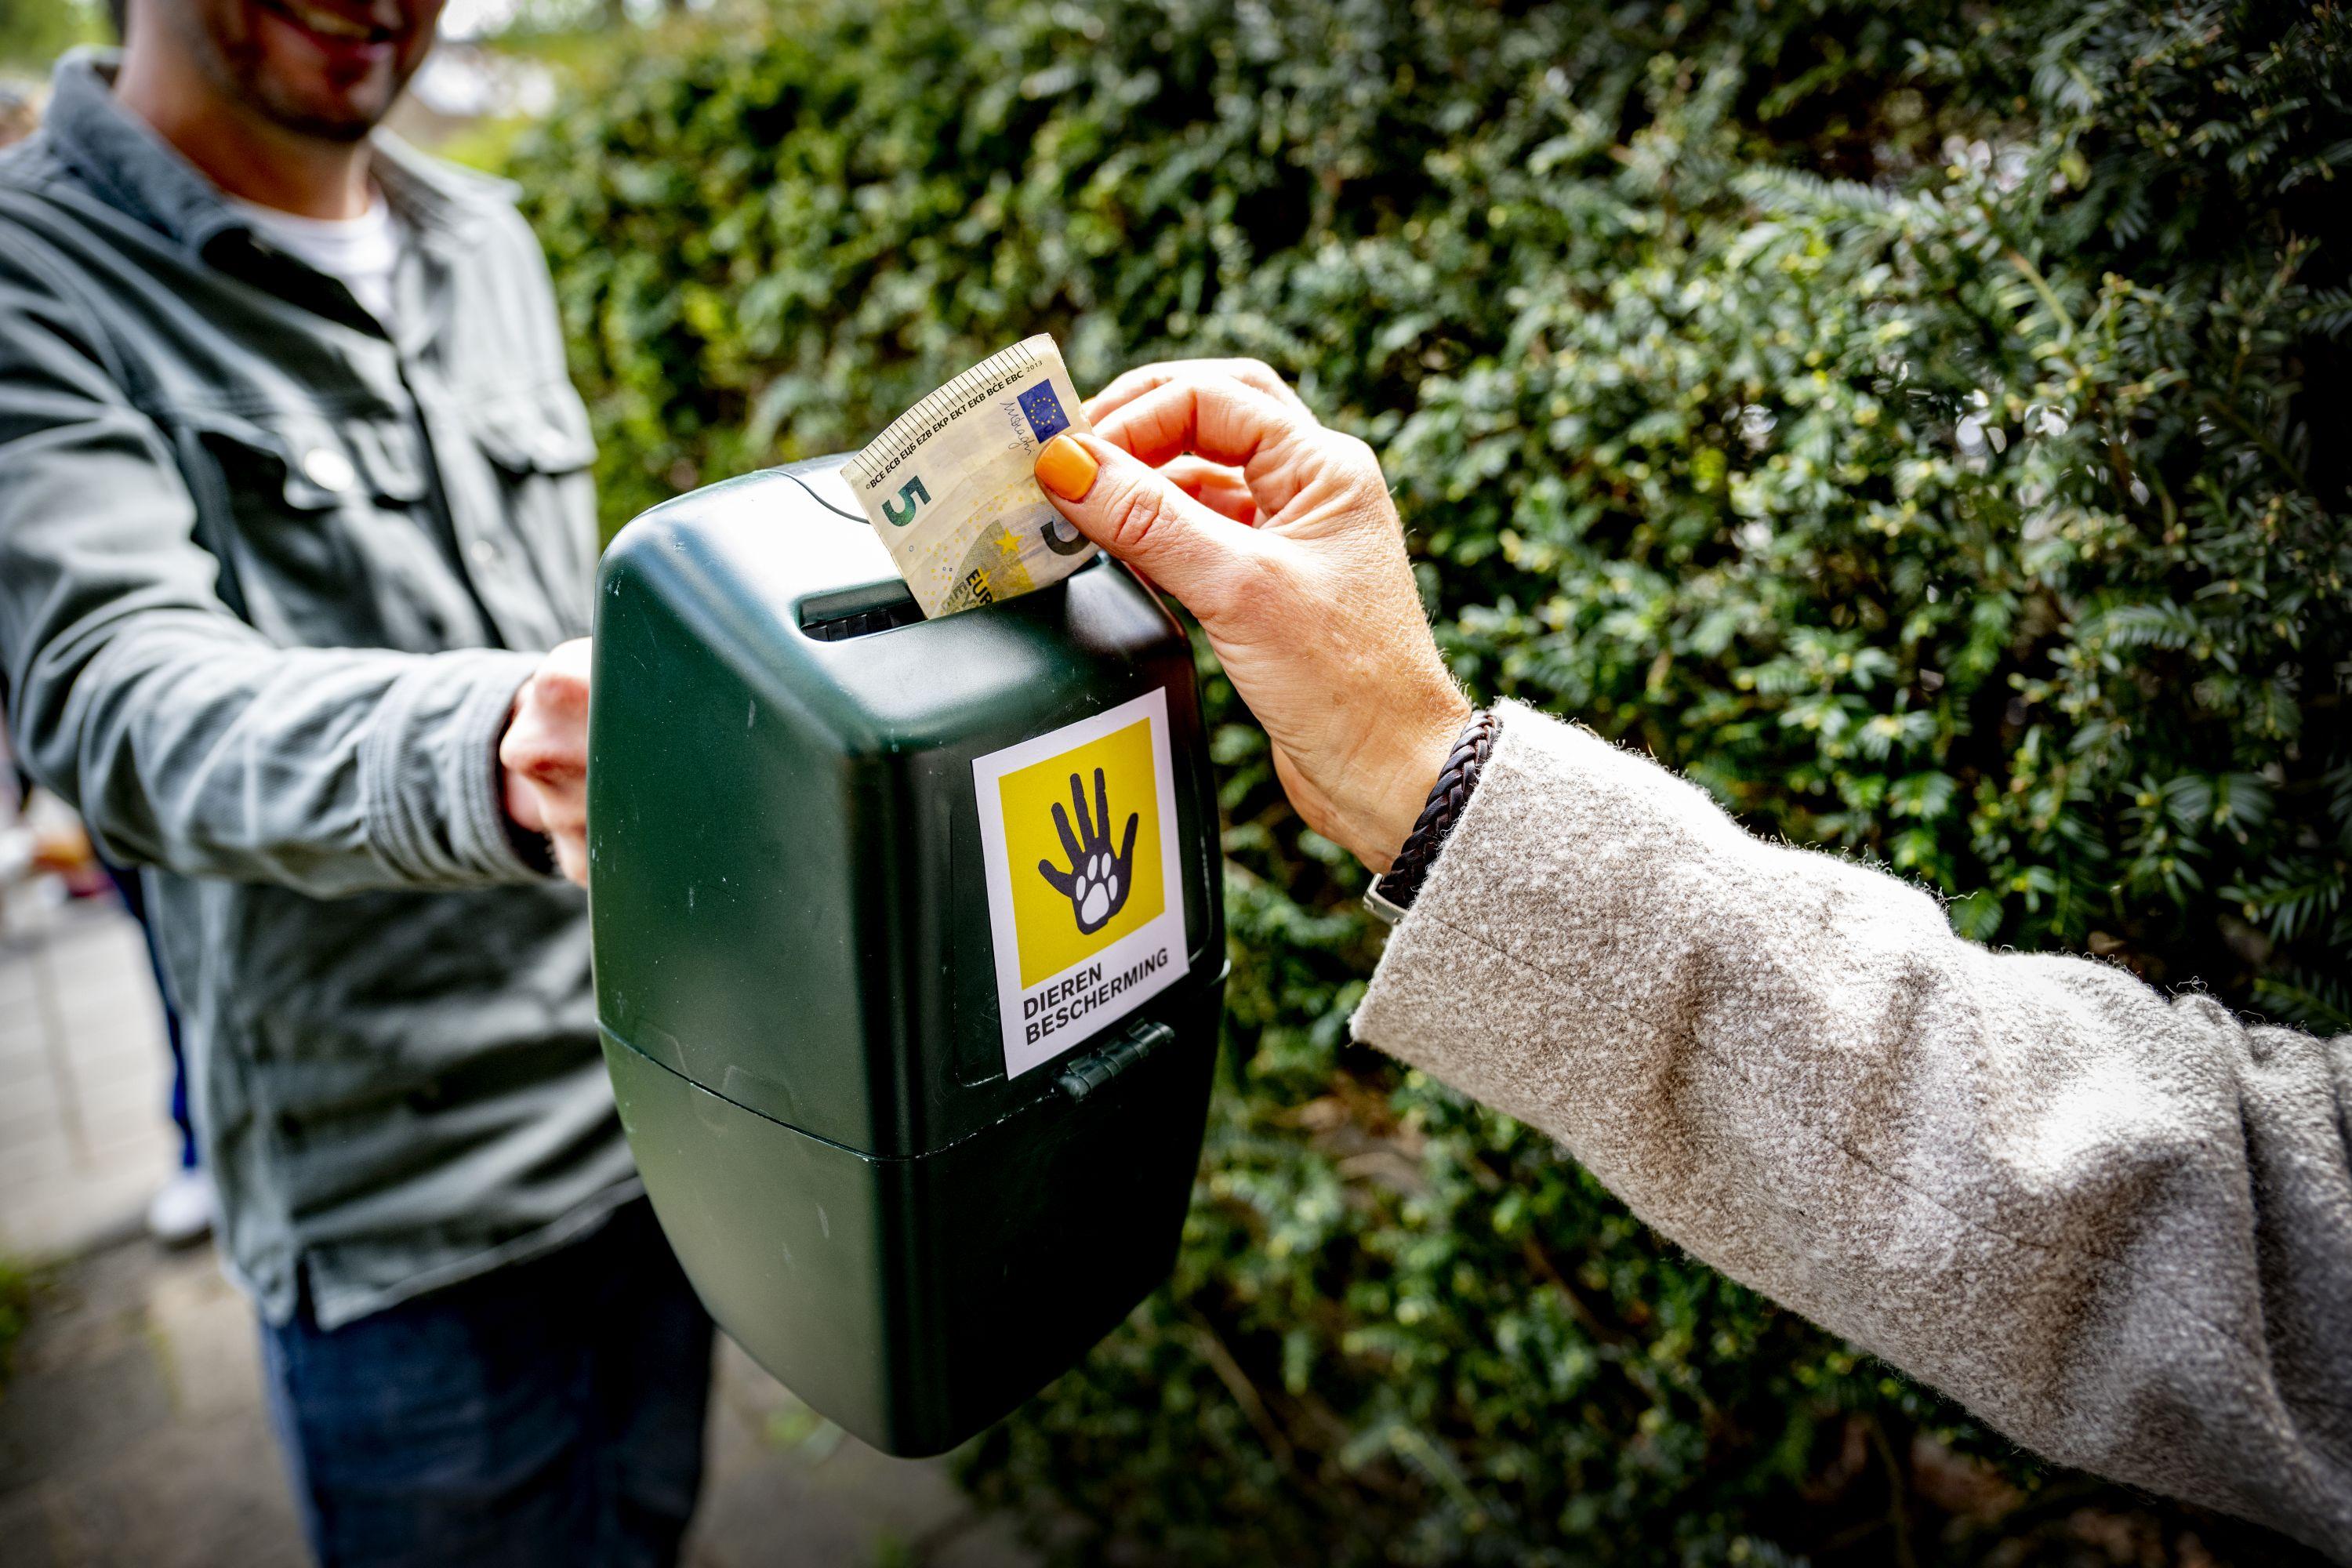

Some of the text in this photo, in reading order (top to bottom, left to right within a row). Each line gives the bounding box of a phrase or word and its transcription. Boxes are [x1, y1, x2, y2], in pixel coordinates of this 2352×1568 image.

[885, 457, 901, 474] ECB
[916, 430, 933, 446] EZB
[932, 417, 949, 433] EKP
[967, 394, 986, 408] EKB
[1005, 371, 1024, 385] EBC
[1025, 360, 1043, 372] 2013
[881, 475, 931, 527] 5
[1023, 963, 1102, 1020] DIEREN
[1025, 948, 1168, 1046] BESCHERMING
